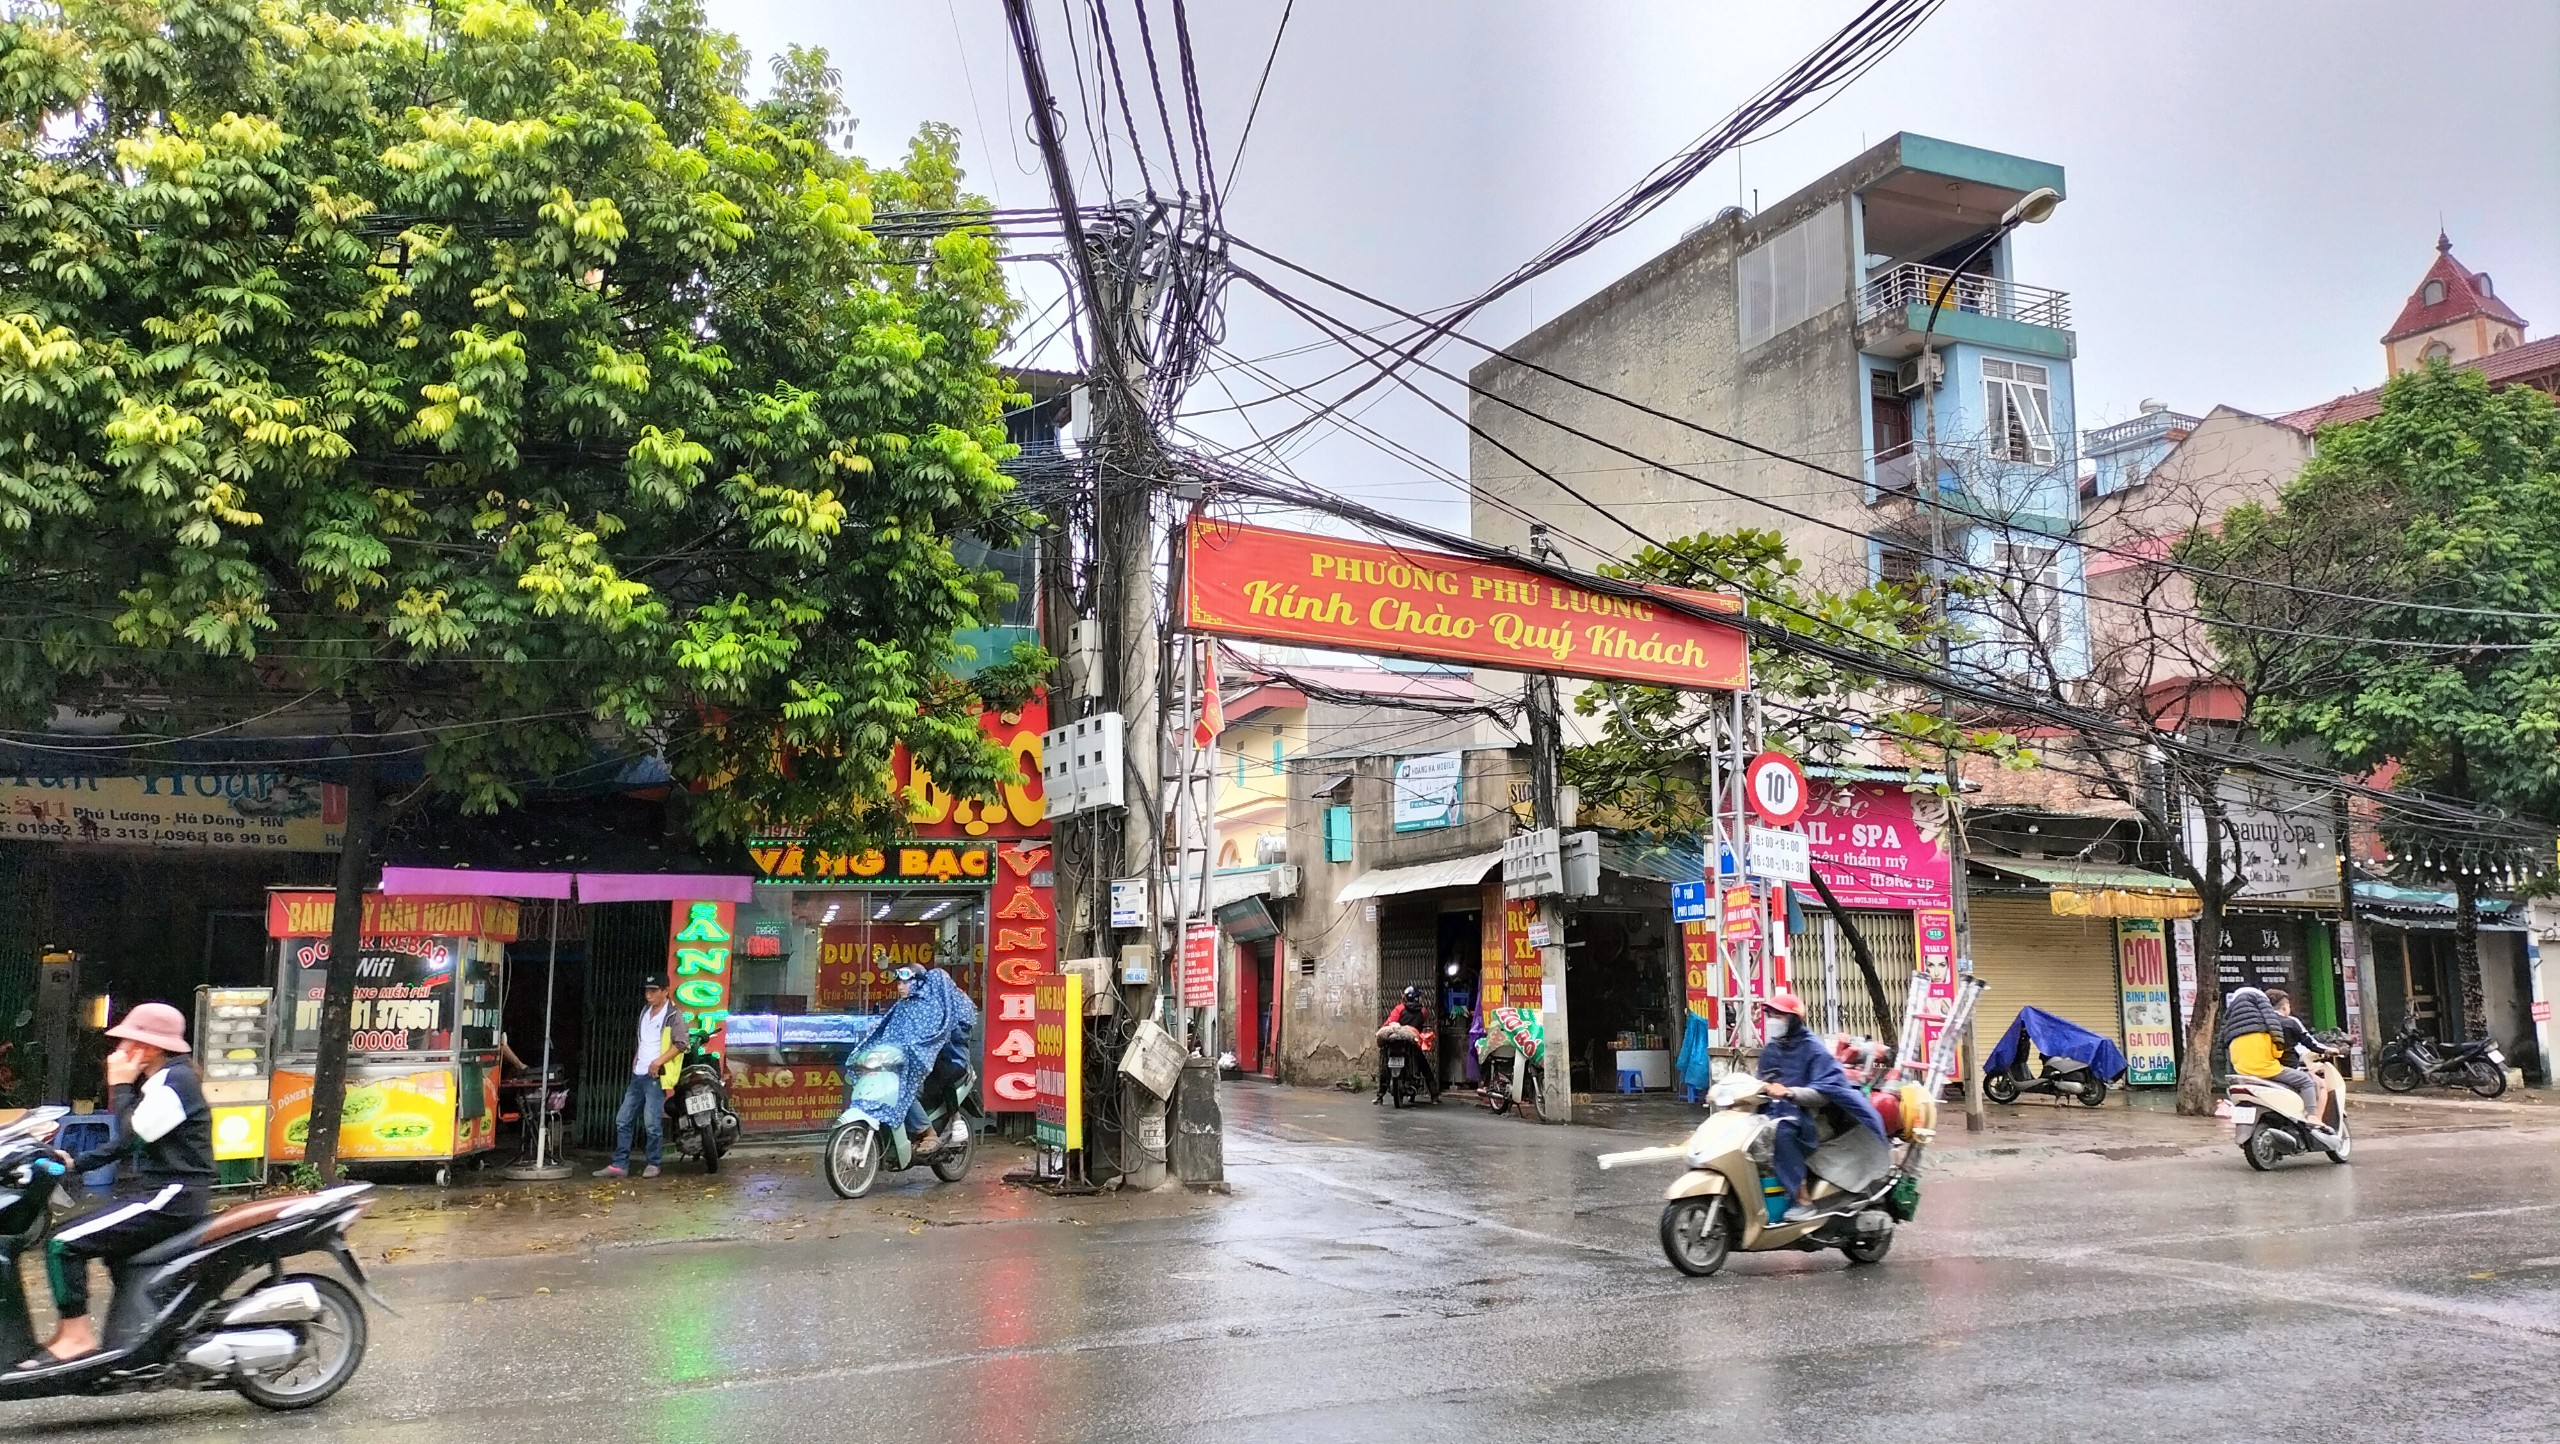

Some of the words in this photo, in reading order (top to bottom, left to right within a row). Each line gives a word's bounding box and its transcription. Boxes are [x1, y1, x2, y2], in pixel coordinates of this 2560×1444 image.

[1310, 553, 1459, 595] PHƯỜNG
[1471, 576, 1539, 606] PHÚ
[1550, 587, 1654, 621] LƯƠNG
[1243, 580, 1359, 626] Kính
[1369, 597, 1484, 639] Chào
[1489, 612, 1577, 661] Quý
[1585, 625, 1709, 668] Khách
[73, 807, 104, 820] Phú
[110, 809, 160, 824] Lương
[176, 812, 198, 825] Hà
[203, 814, 245, 828] Đông
[260, 817, 284, 828] HN
[2283, 812, 2317, 853] Spa
[117, 828, 148, 839] 313
[213, 832, 234, 844] 86
[240, 833, 261, 844] 99
[267, 834, 288, 845] 56
[1793, 819, 1832, 846] AIL
[1852, 823, 1902, 849] SPA
[899, 849, 988, 881] BẠC
[1844, 849, 1881, 868] thẩm
[1885, 854, 1908, 870] mỹ
[1869, 873, 1913, 888] Make
[1917, 877, 1935, 890] up
[288, 898, 334, 932] BÁN
[422, 903, 473, 931] HOAN
[824, 943, 867, 964] DUY
[1514, 938, 1536, 959] XE
[2123, 934, 2164, 986] CƠM
[1036, 1023, 1063, 1057] 9999
